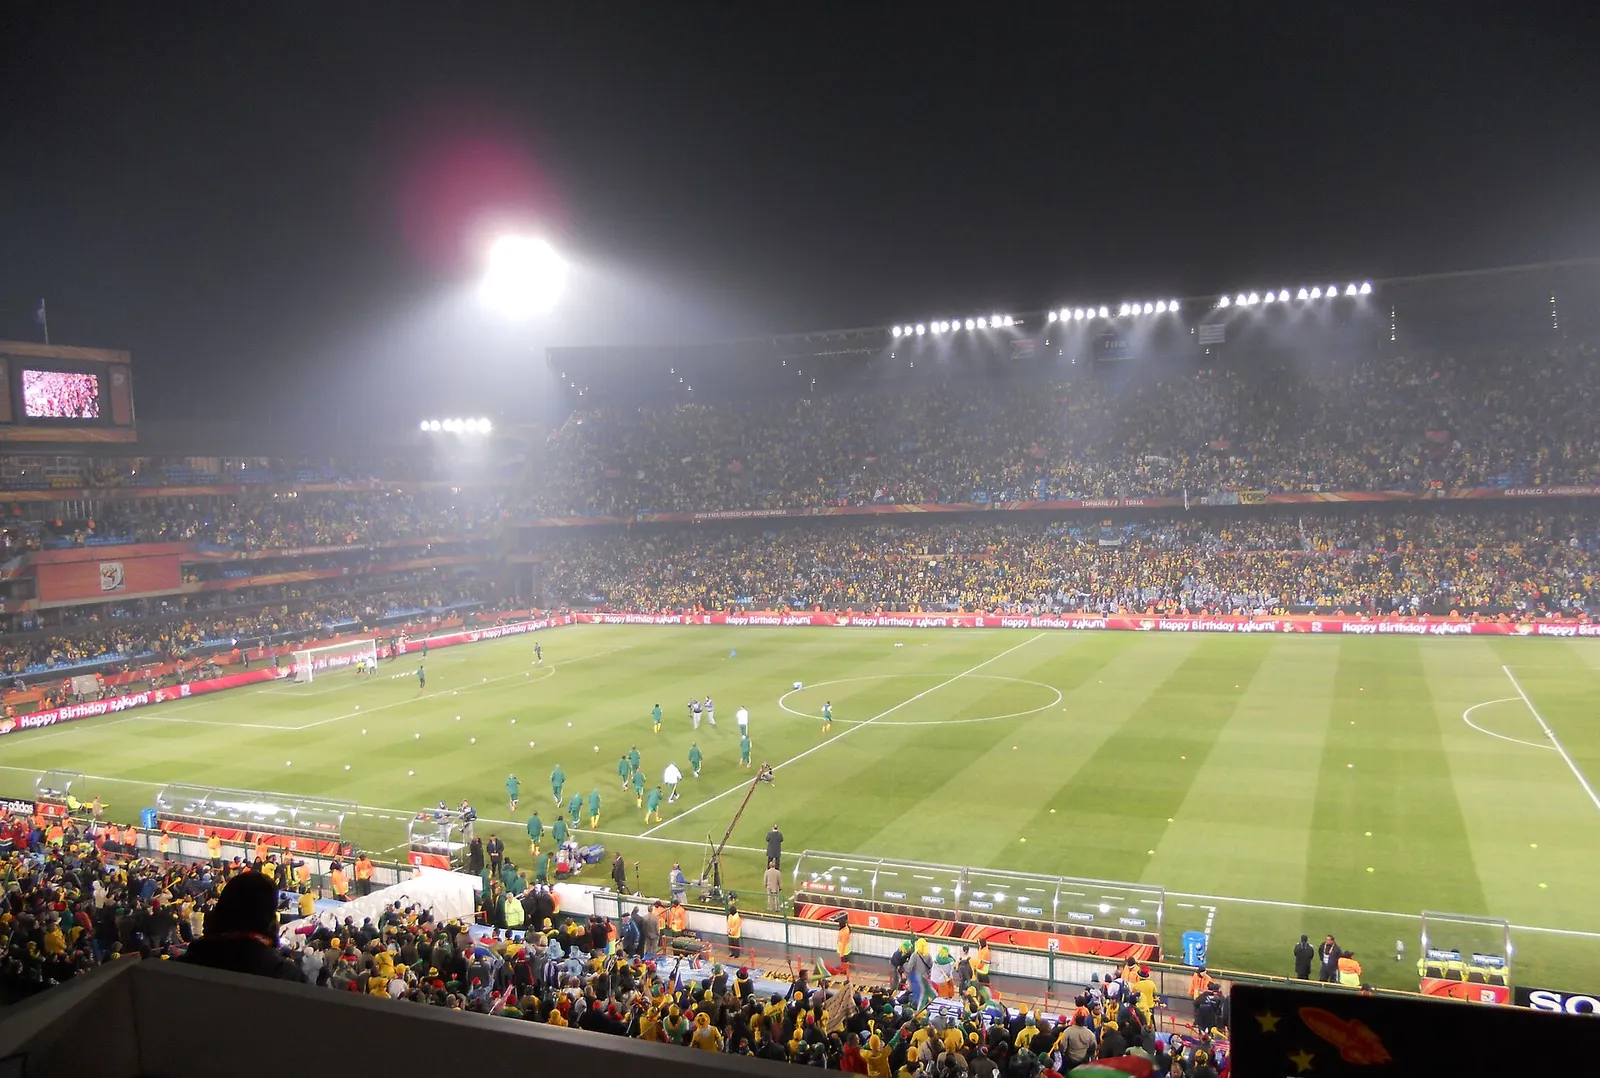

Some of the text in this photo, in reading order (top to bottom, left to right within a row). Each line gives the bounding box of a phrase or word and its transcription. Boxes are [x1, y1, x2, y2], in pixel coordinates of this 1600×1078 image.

[726, 616, 748, 625] Happy
[750, 616, 781, 625] Birthday
[852, 617, 877, 626] Happy
[879, 617, 913, 627] Birthday
[1002, 619, 1029, 628] Happy
[1031, 618, 1069, 628] Birthday
[1160, 621, 1190, 631] Happy
[1192, 621, 1235, 631] Birthday
[1342, 622, 1376, 633] Happy
[1379, 622, 1427, 634] Birthday
[1538, 624, 1576, 636] Happy
[21, 712, 57, 727] Happy
[60, 699, 108, 720] Birthday
[8, 801, 33, 814] adidas
